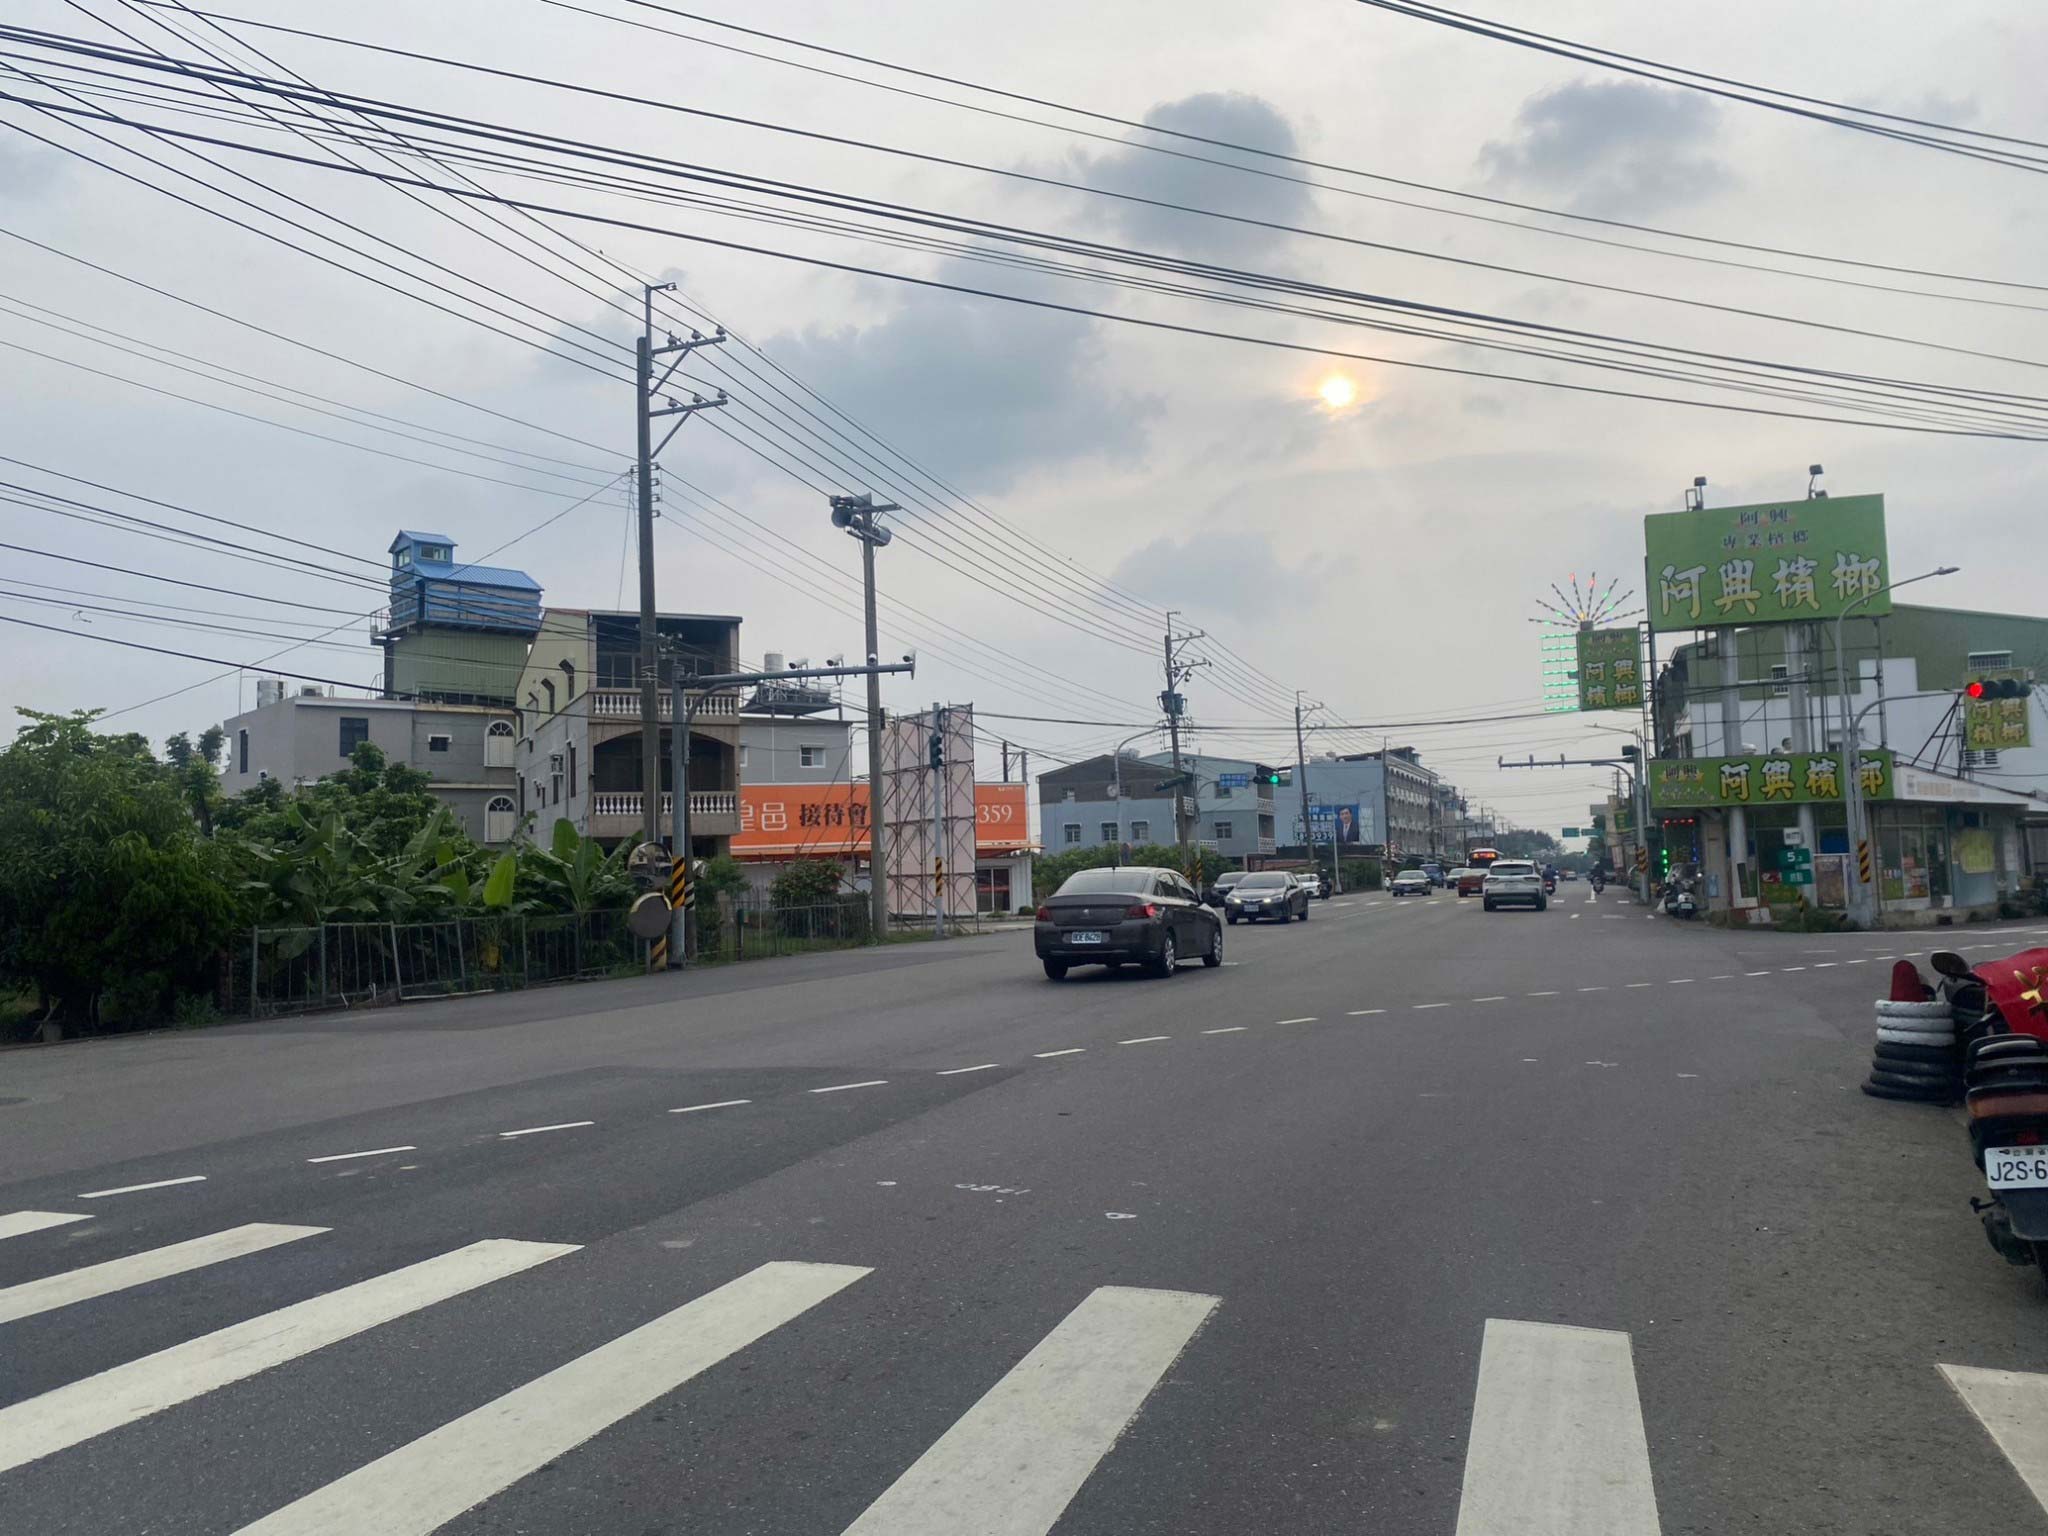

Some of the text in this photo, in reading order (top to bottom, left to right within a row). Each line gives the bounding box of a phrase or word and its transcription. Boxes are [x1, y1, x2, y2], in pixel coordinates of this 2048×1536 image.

[1659, 551, 1881, 619] 阿興檳榔
[975, 804, 1012, 824] 359
